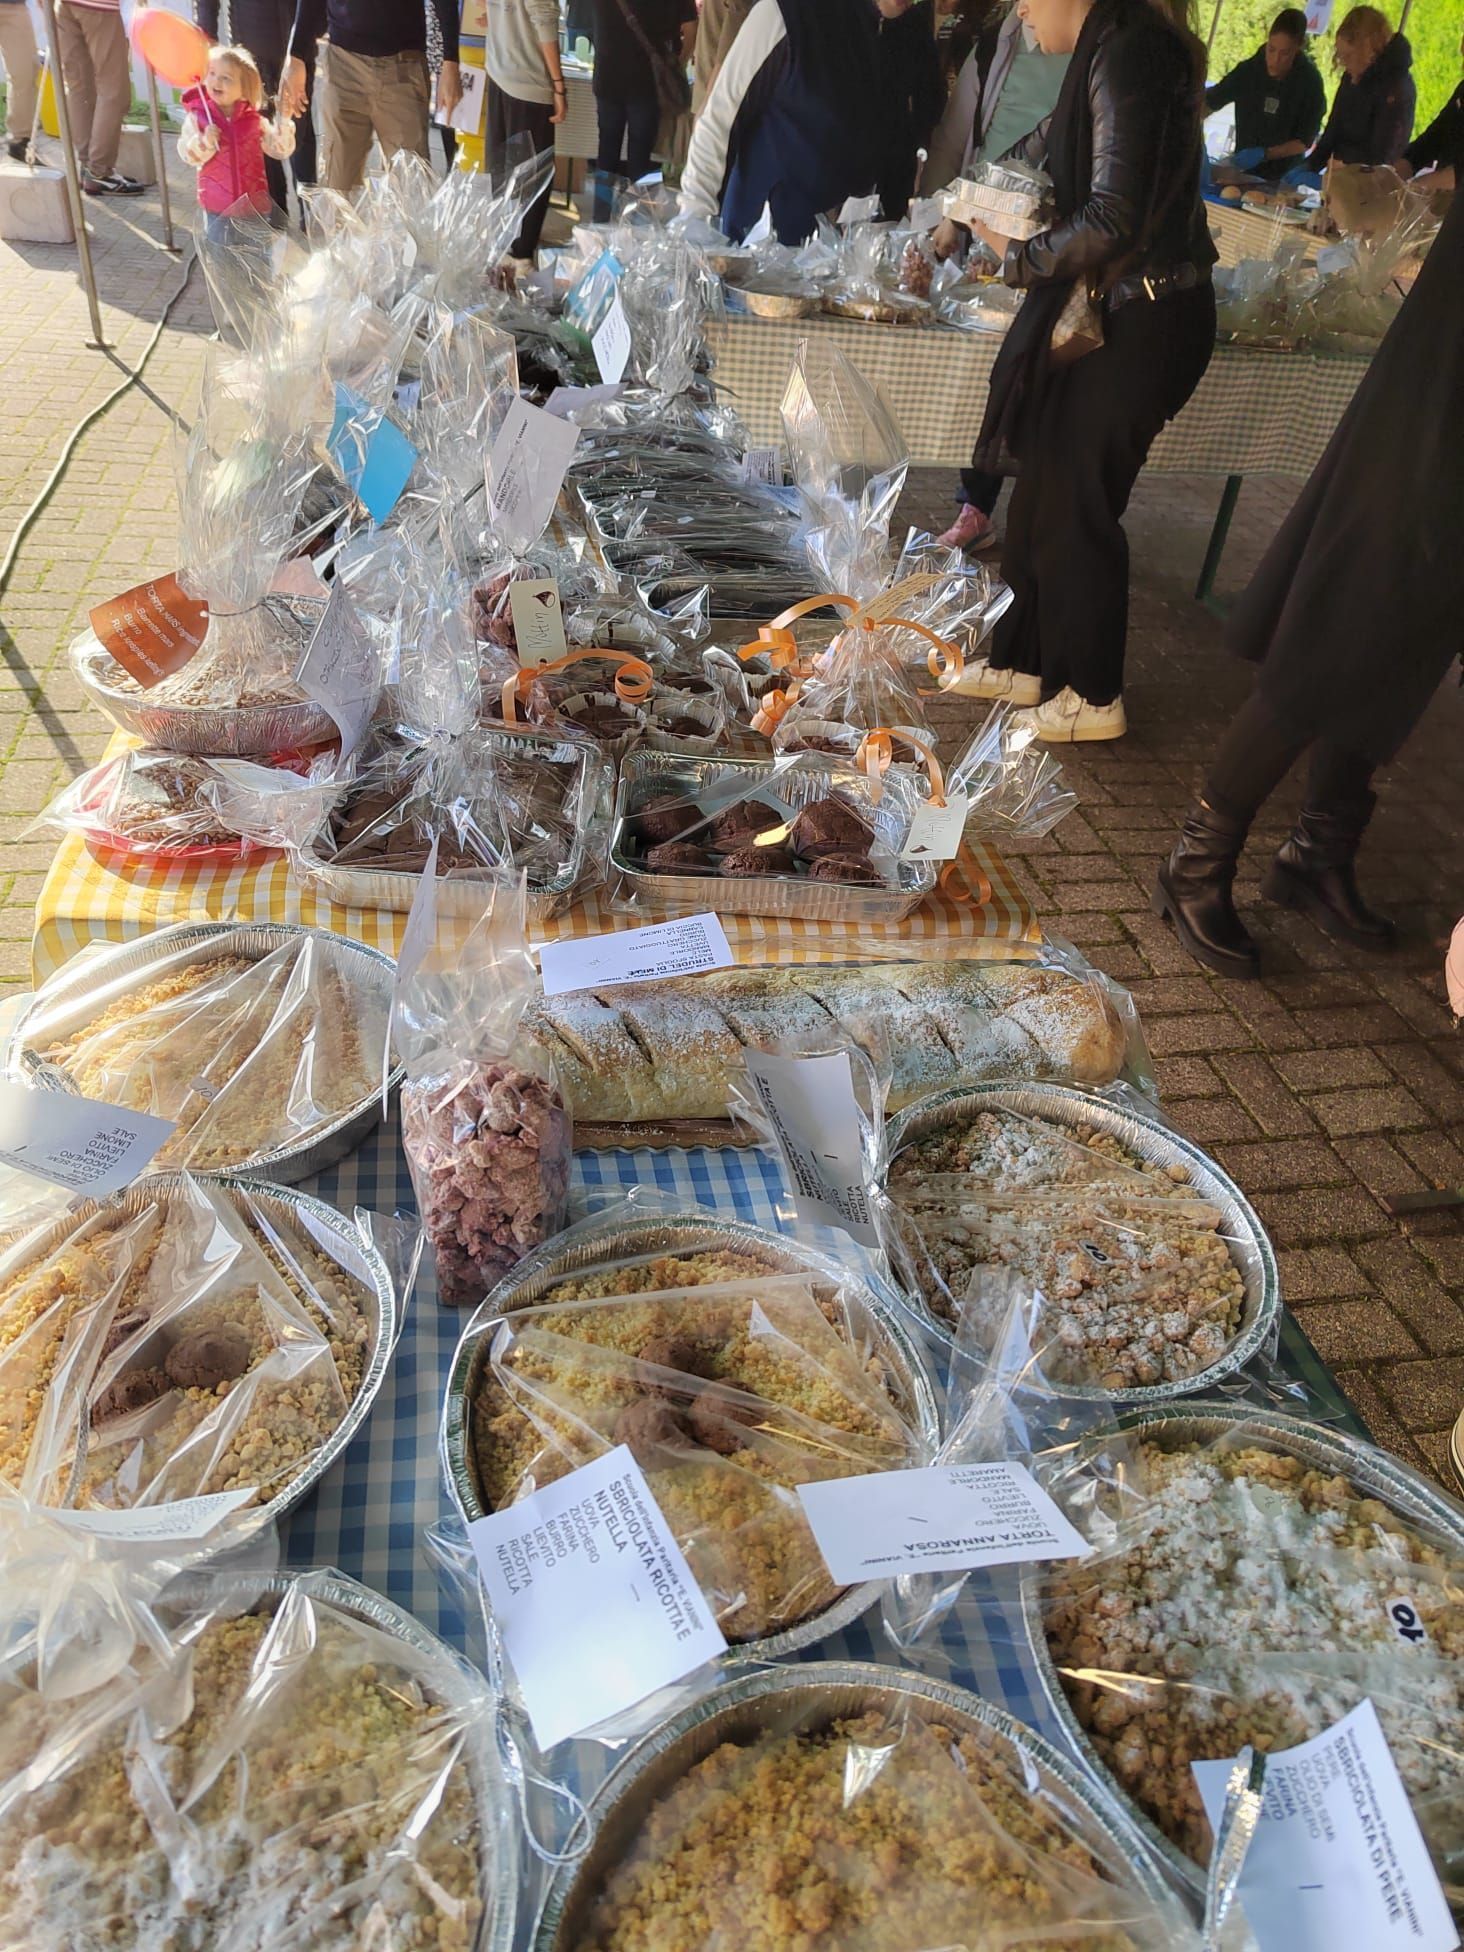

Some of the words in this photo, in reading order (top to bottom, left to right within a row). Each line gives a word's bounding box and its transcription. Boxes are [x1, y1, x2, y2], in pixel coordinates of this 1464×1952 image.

[144, 583, 165, 613] TORTA
[669, 956, 715, 968] STRUDEL
[92, 1130, 133, 1148] LIMONE
[110, 1127, 138, 1140] SALE
[58, 1149, 114, 1171] ZUCCHERO
[82, 1147, 120, 1164] FARINA
[86, 1139, 127, 1156] LIEVITO
[69, 1161, 82, 1169] DI
[80, 1164, 107, 1177] OLIO
[842, 1200, 855, 1222] SALE
[845, 1184, 862, 1224] RICOTTA
[853, 1183, 869, 1224] NUTELLA
[1086, 1243, 1107, 1262] 10
[947, 1472, 1012, 1485] MANDORLE
[948, 1466, 1007, 1478] AMARETTI
[965, 1479, 1017, 1490] RICOTTA
[979, 1492, 1027, 1503] LIEVITO
[990, 1486, 1022, 1494] SALE
[579, 1497, 602, 1530] UOVA
[987, 1499, 1032, 1510] BURRO
[991, 1506, 1037, 1517] FARINA
[556, 1511, 581, 1553] FARINA
[592, 1489, 630, 1553] NUTELLA
[620, 1472, 641, 1500] Scuola
[655, 1546, 681, 1586] Paritaria
[973, 1513, 1043, 1526] ZUCCHERO
[1010, 1520, 1048, 1530] UOVA
[519, 1531, 539, 1562] SALE
[532, 1524, 557, 1569] LIEVITO
[544, 1518, 569, 1560] BURRO
[568, 1504, 601, 1565] ZUCCHERO
[902, 1534, 998, 1551] ANNAROSA
[997, 1528, 1054, 1541] TORTA
[494, 1542, 521, 1596] NUTELLA
[507, 1536, 534, 1589] RICOTTA
[606, 1479, 659, 1570] SBRICIOLATA
[647, 1567, 688, 1634] RICOTTA
[675, 1626, 692, 1642] E
[1391, 1603, 1425, 1643] 10
[1309, 1751, 1332, 1790] UOVA
[1320, 1744, 1342, 1779] PERE
[1270, 1766, 1299, 1818] FARINA
[1296, 1758, 1318, 1792] OLIO
[1309, 1791, 1325, 1809] DI
[1332, 1735, 1380, 1848] SBRICIOLATA
[1282, 1763, 1323, 1840] ZUCCHERO
[1368, 1847, 1386, 1869] DI
[1374, 1869, 1405, 1924] PERE
